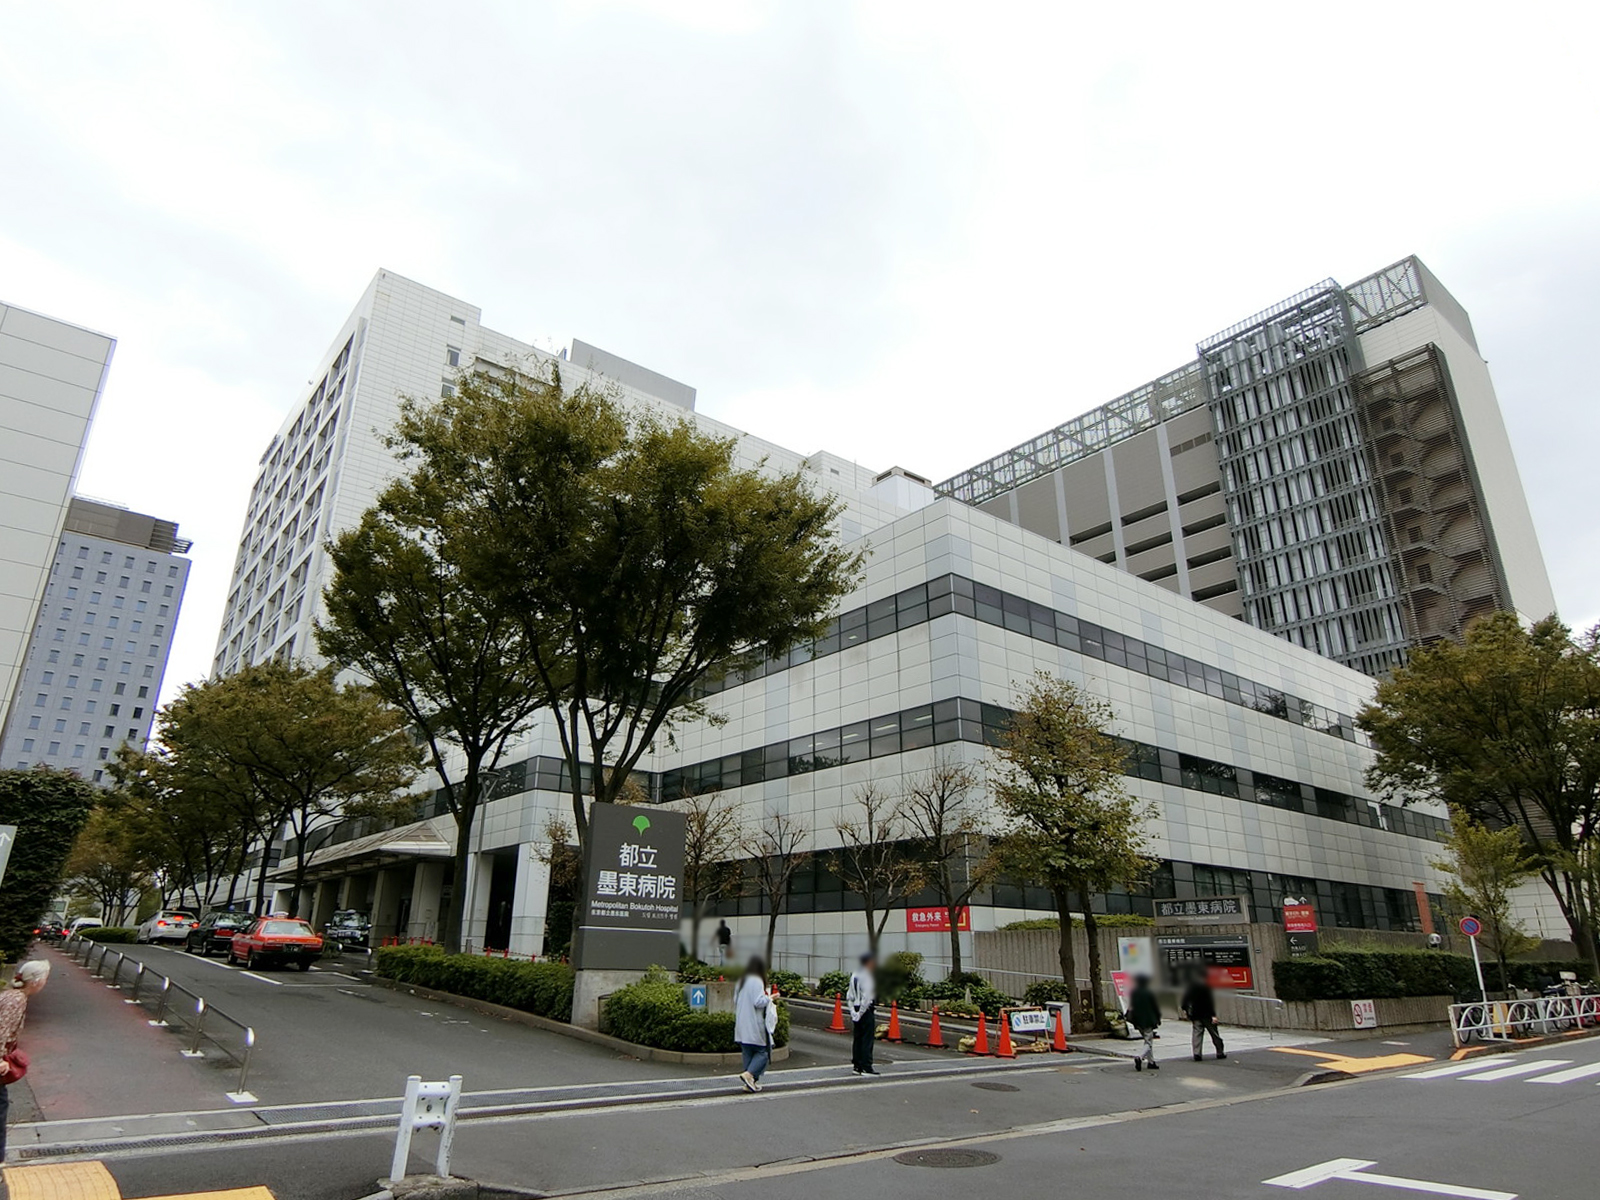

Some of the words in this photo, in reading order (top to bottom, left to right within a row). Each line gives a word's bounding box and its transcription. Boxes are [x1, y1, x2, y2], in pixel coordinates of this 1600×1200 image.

[619, 842, 658, 869] 都立
[596, 870, 676, 899] 墨東病院
[591, 900, 629, 910] Metropolitan
[629, 902, 655, 911] Bokutoh
[655, 904, 679, 913] Hospital
[1161, 899, 1237, 916] 都立墨東病院
[911, 911, 942, 922] 救急外来
